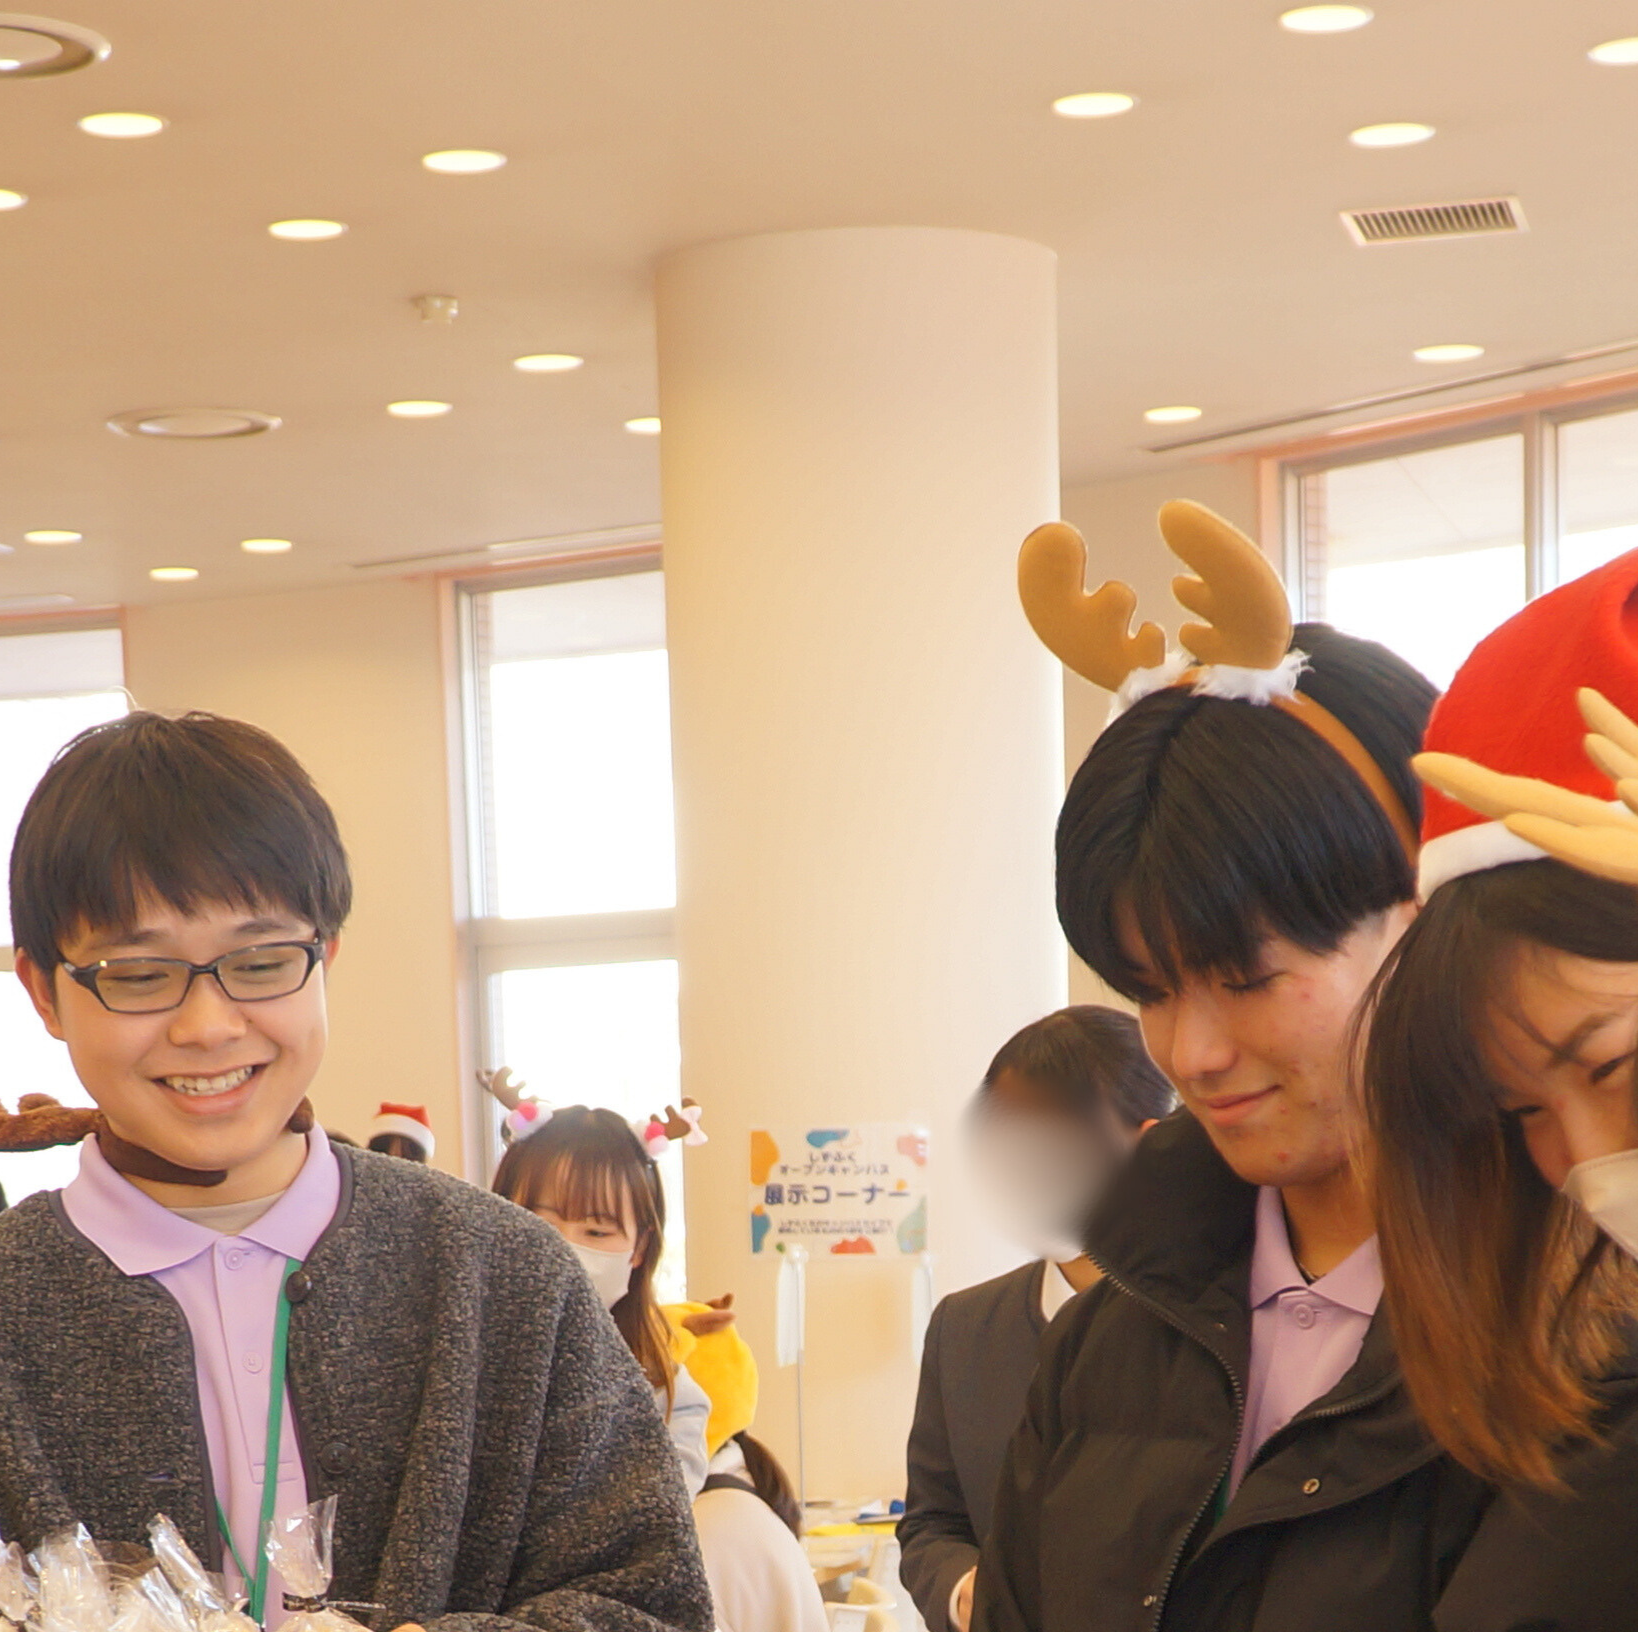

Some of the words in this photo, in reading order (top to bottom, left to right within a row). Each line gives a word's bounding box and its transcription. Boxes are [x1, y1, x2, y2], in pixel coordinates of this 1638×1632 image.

[764, 1184, 910, 1205] 展示コーナー
